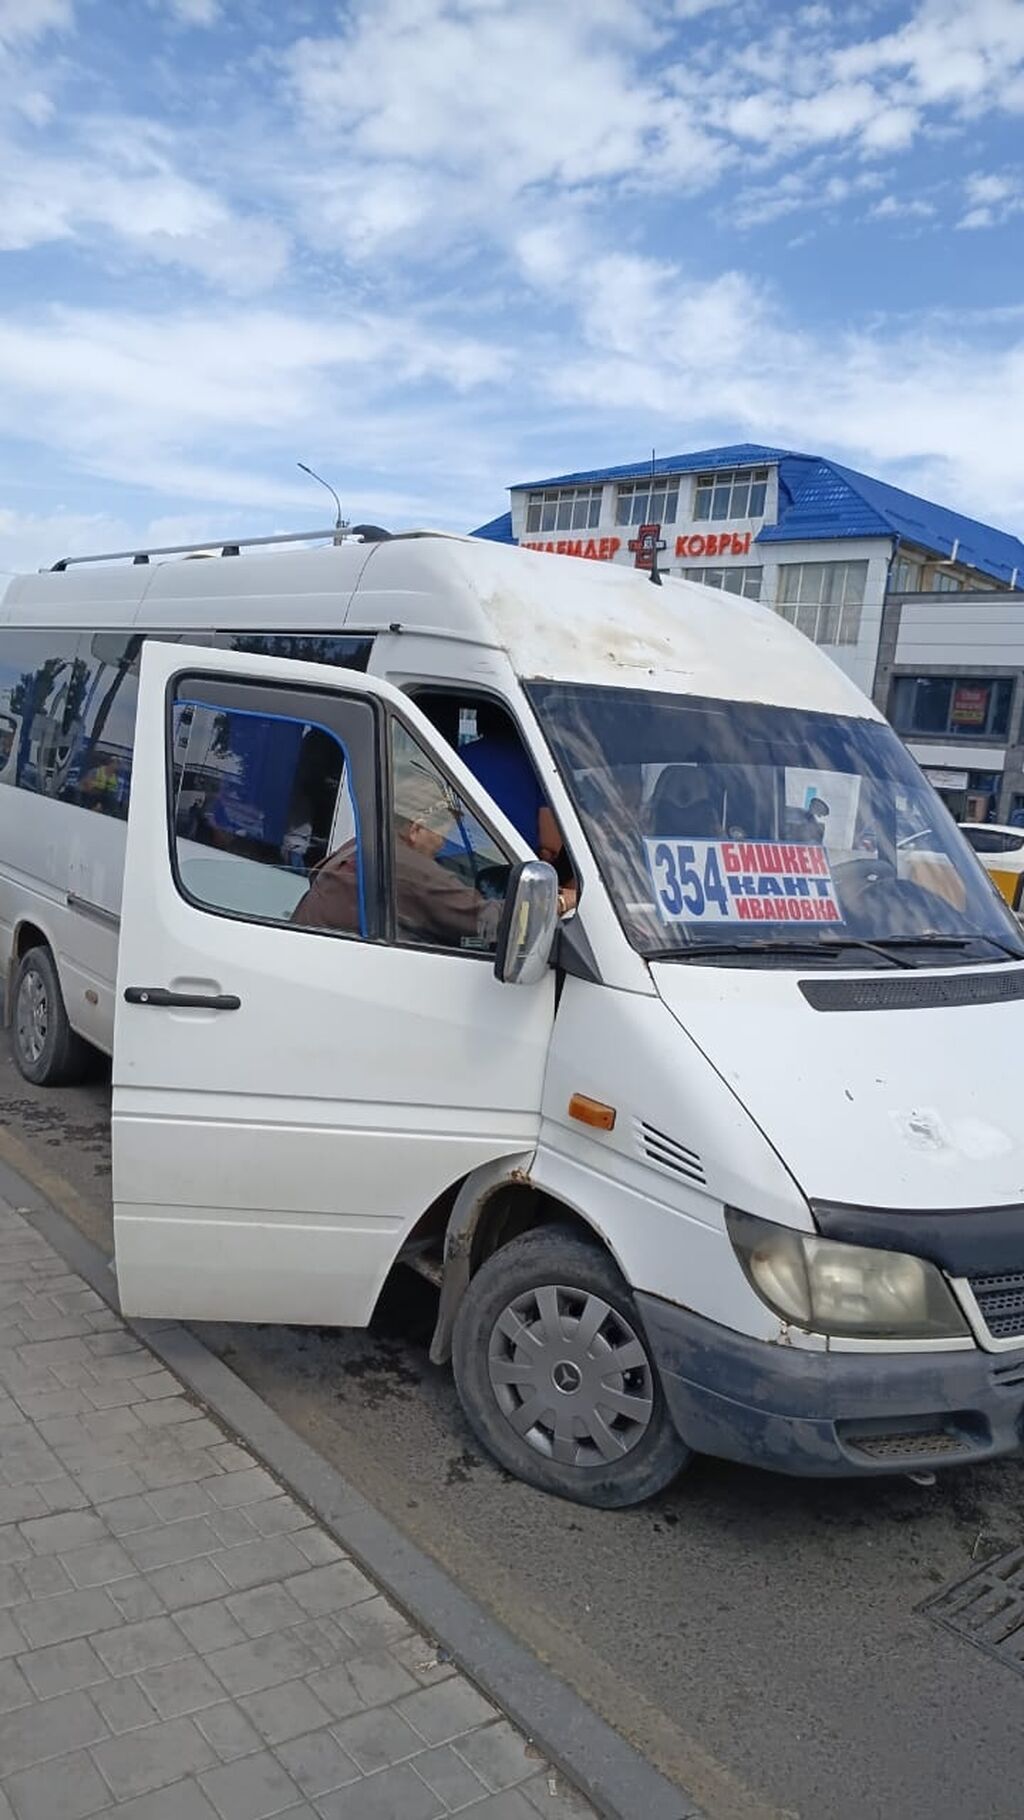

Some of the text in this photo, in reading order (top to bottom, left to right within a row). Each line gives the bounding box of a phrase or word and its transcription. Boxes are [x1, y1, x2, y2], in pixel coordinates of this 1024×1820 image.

[675, 532, 751, 557] КОВРЫ
[721, 843, 828, 875] БИШКЕК
[655, 843, 729, 916] 354
[727, 875, 832, 897] КАНТ
[736, 897, 839, 921] ИВАНОВКА
